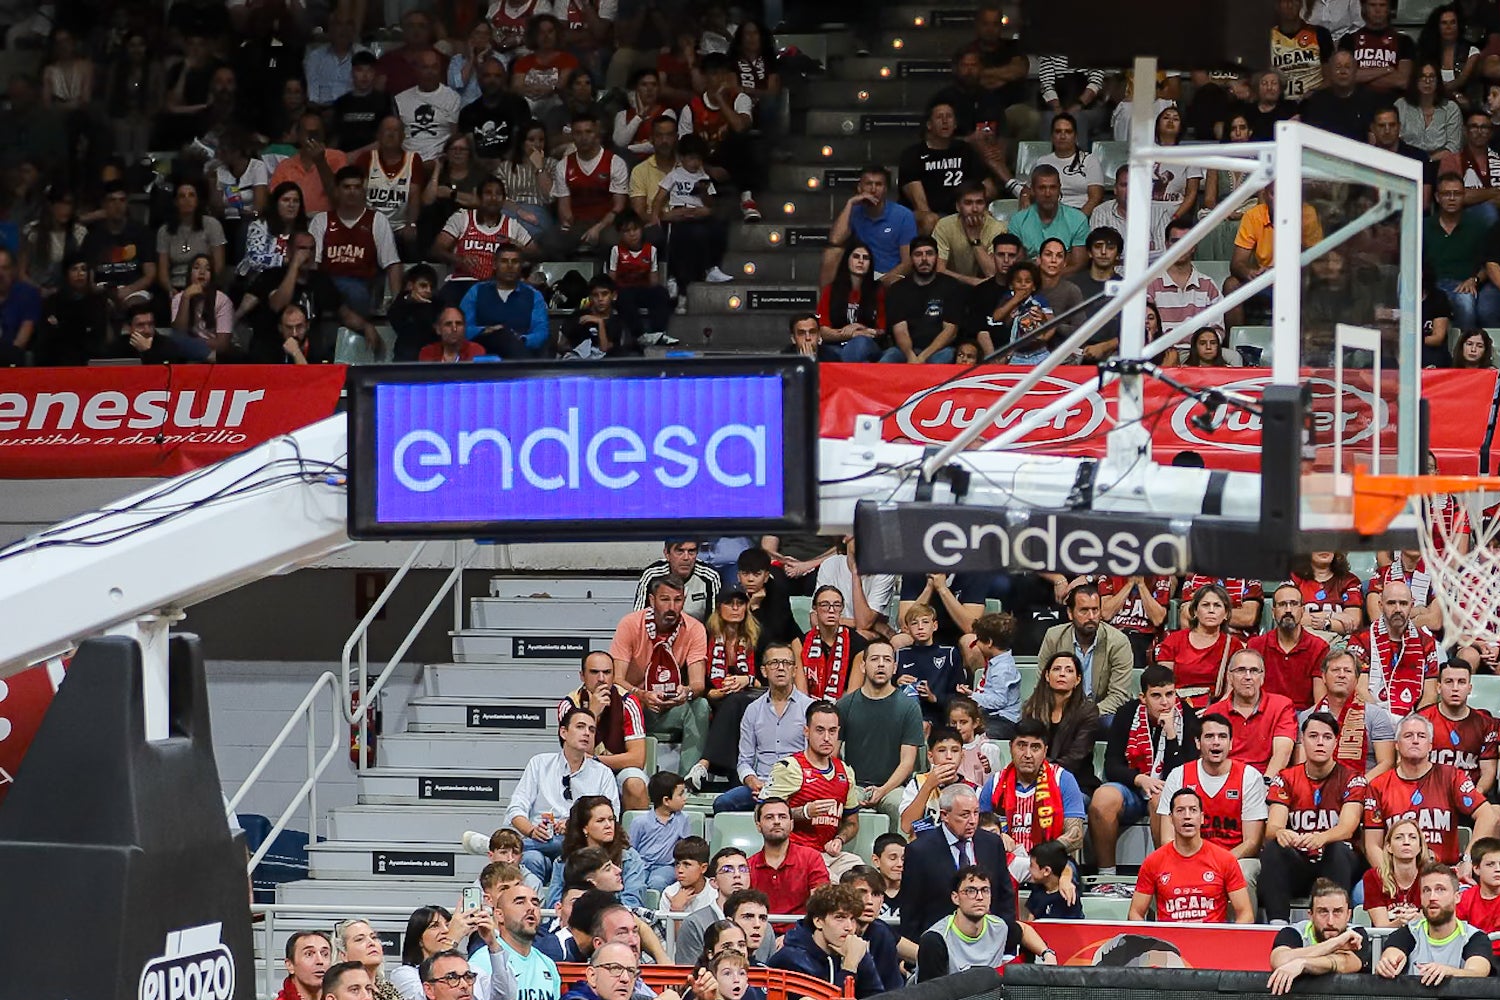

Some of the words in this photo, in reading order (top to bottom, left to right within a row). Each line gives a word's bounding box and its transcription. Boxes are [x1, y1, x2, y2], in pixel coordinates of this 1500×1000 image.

[1273, 50, 1315, 67] UCAM
[1354, 48, 1397, 63] UCAM
[1288, 80, 1304, 96] 13
[924, 157, 962, 171] MIAMI
[943, 171, 963, 187] 22
[369, 190, 406, 204] UCAM
[327, 244, 365, 259] UCAM
[464, 240, 499, 253] UCA
[920, 398, 1088, 437] Juver
[1192, 398, 1354, 438] Juer
[118, 430, 248, 446] domicilio
[393, 407, 767, 492] endesa
[923, 514, 1192, 576] endesa
[1289, 809, 1341, 831] UCAM
[388, 859, 422, 867] Ayuntamiento
[430, 860, 449, 868] Murcia
[1164, 896, 1216, 913] UCAM
[1171, 910, 1209, 919] MURCIA
